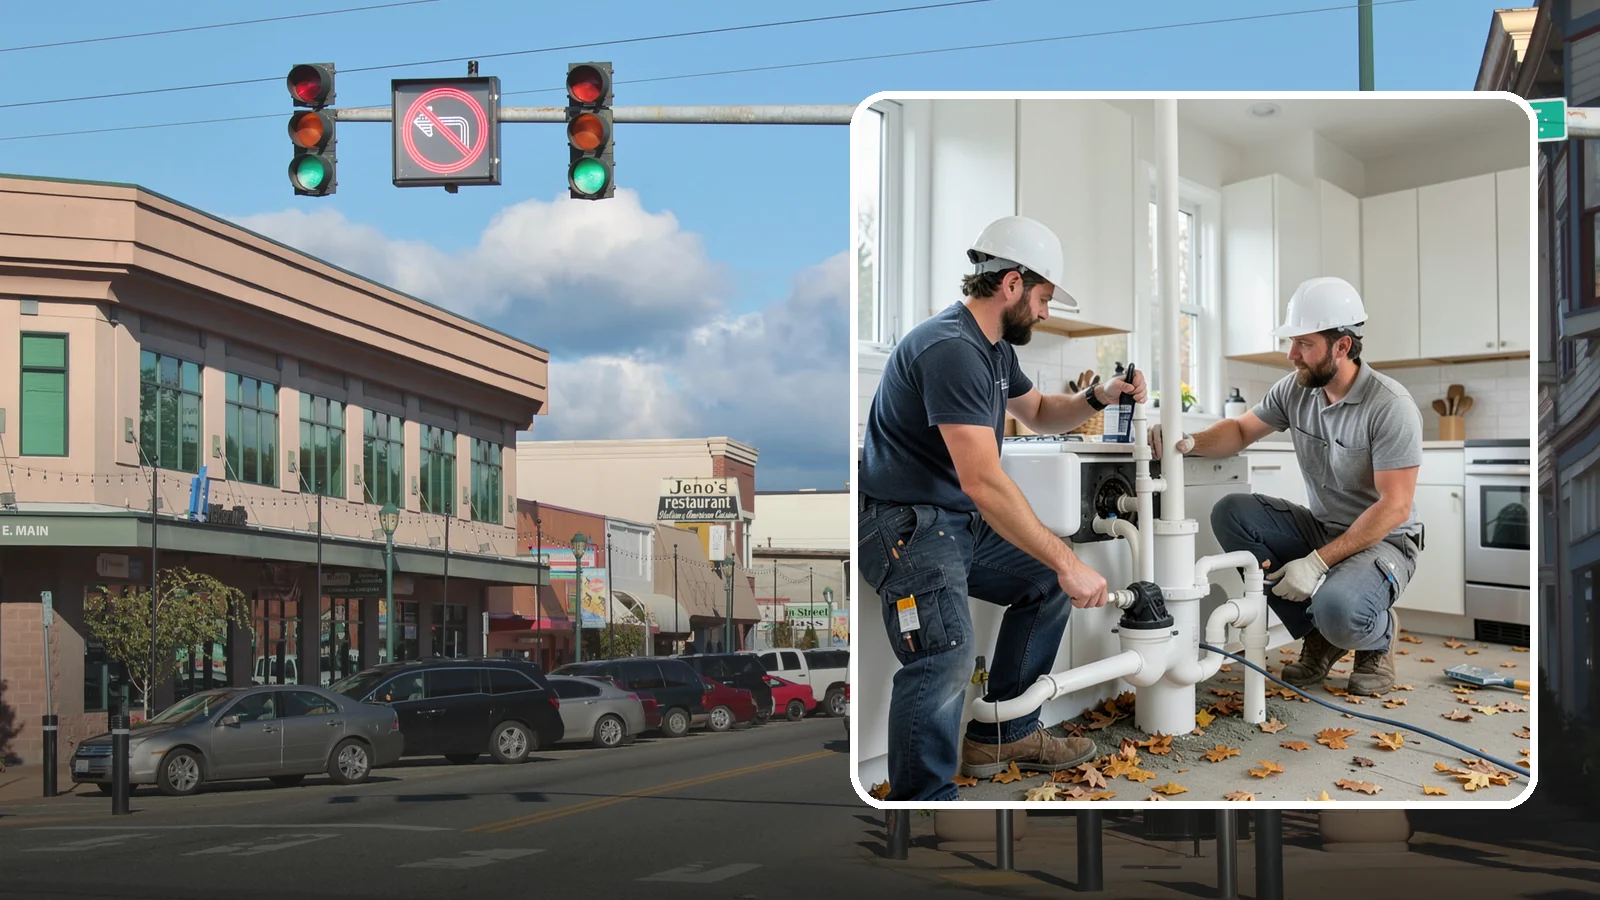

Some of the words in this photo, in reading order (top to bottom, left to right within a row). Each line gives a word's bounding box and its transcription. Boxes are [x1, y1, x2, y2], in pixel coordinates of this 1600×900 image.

[670, 480, 727, 494] Jeno's
[665, 496, 731, 509] restaurant
[686, 510, 714, 519] American
[715, 510, 737, 519] Cuisine
[2, 525, 13, 536] E.
[15, 525, 49, 536] MAIN
[797, 607, 828, 616] Street
